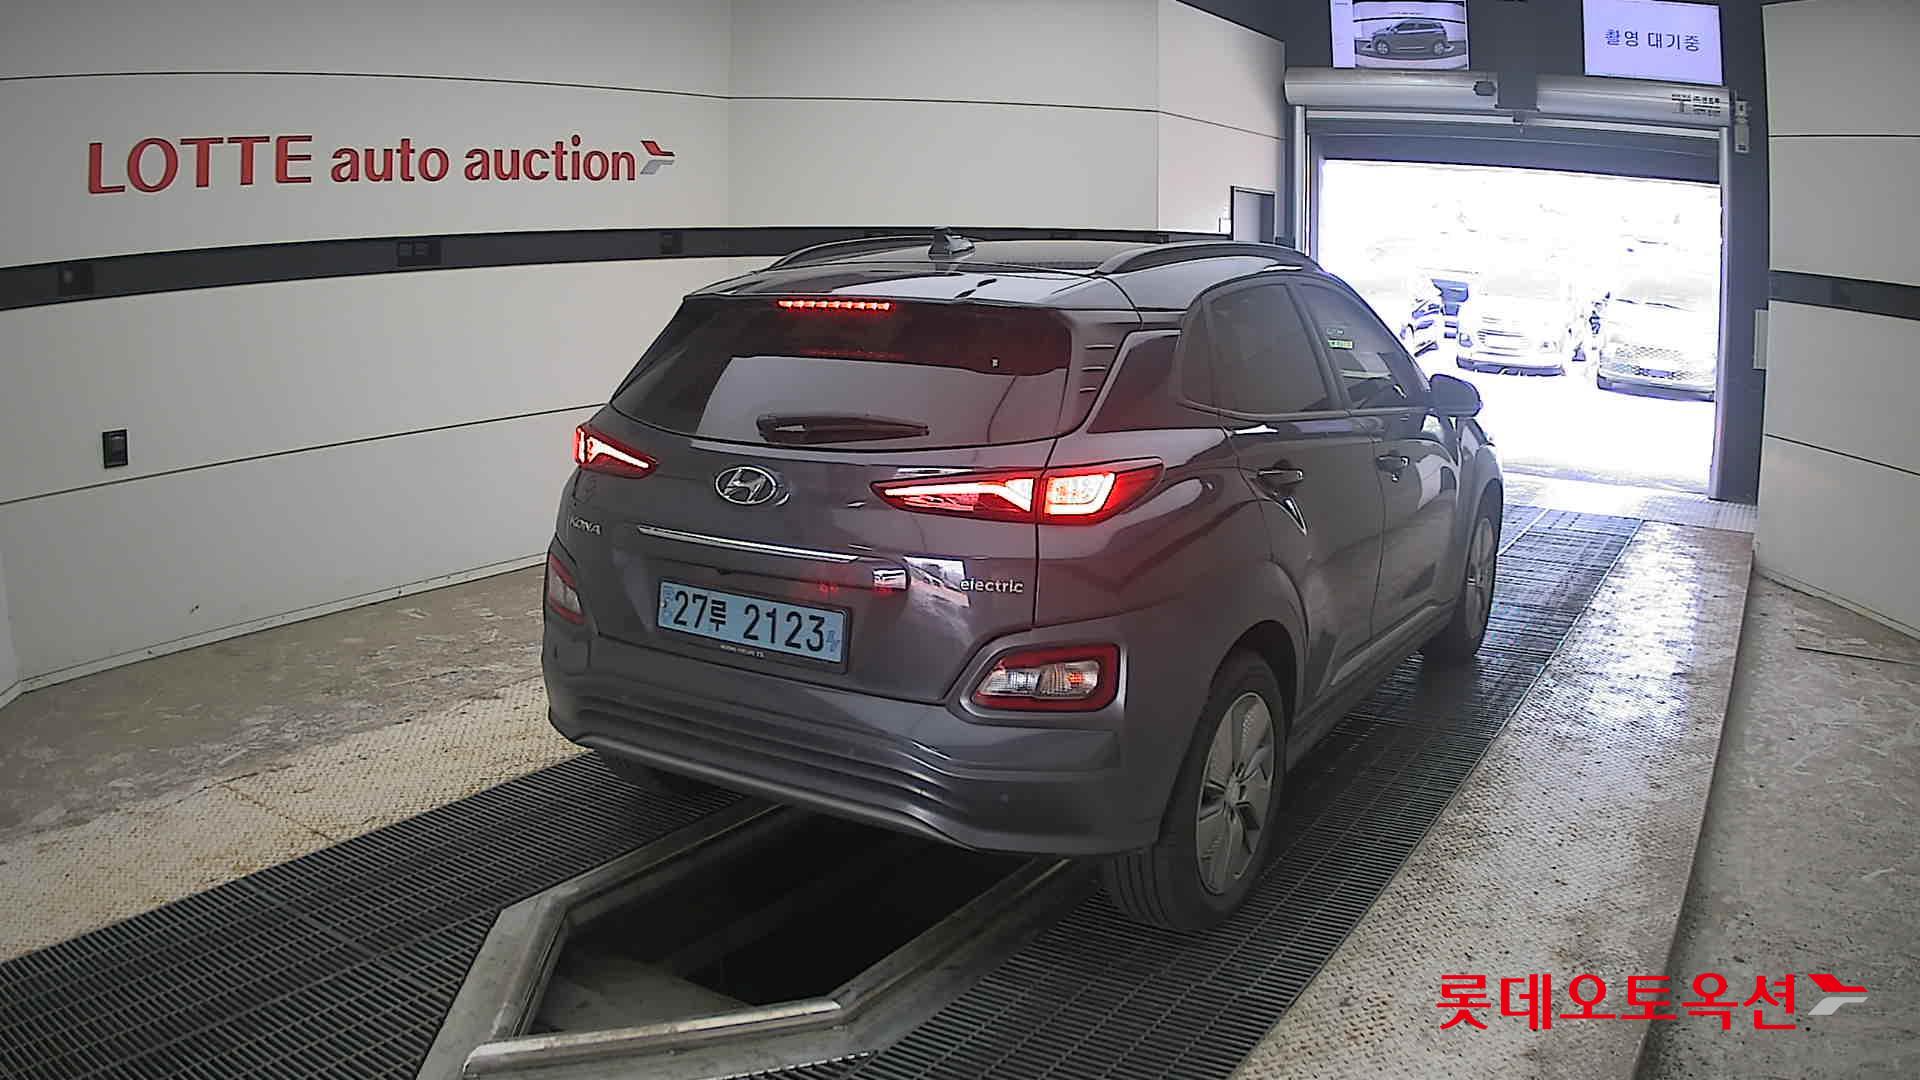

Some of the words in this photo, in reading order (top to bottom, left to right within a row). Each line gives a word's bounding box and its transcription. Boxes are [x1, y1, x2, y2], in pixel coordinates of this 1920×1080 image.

[1647, 32, 1701, 52] 대기중
[88, 135, 312, 194] LOTTE
[331, 138, 450, 183] auto
[464, 134, 636, 182] auction
[960, 577, 1024, 593] electric
[743, 603, 825, 652] 2123
